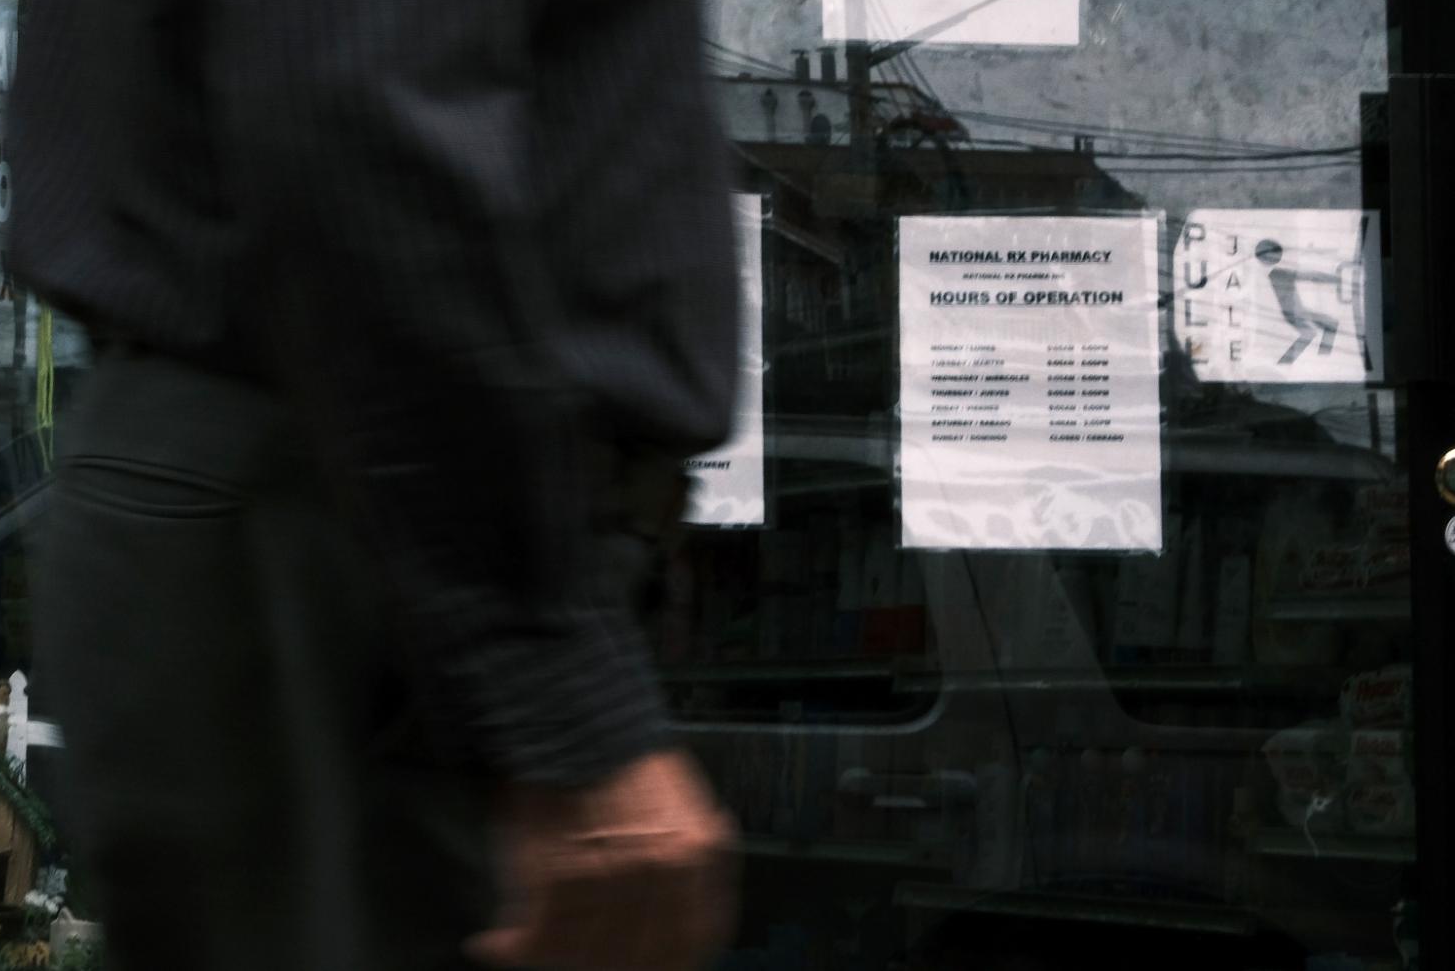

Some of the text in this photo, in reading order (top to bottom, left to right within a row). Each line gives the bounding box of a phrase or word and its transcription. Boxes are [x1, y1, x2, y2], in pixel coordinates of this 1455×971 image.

[929, 250, 1112, 263] NATIONAL RX PHARMACY
[930, 291, 1123, 305] HOURS OF OPERATION
